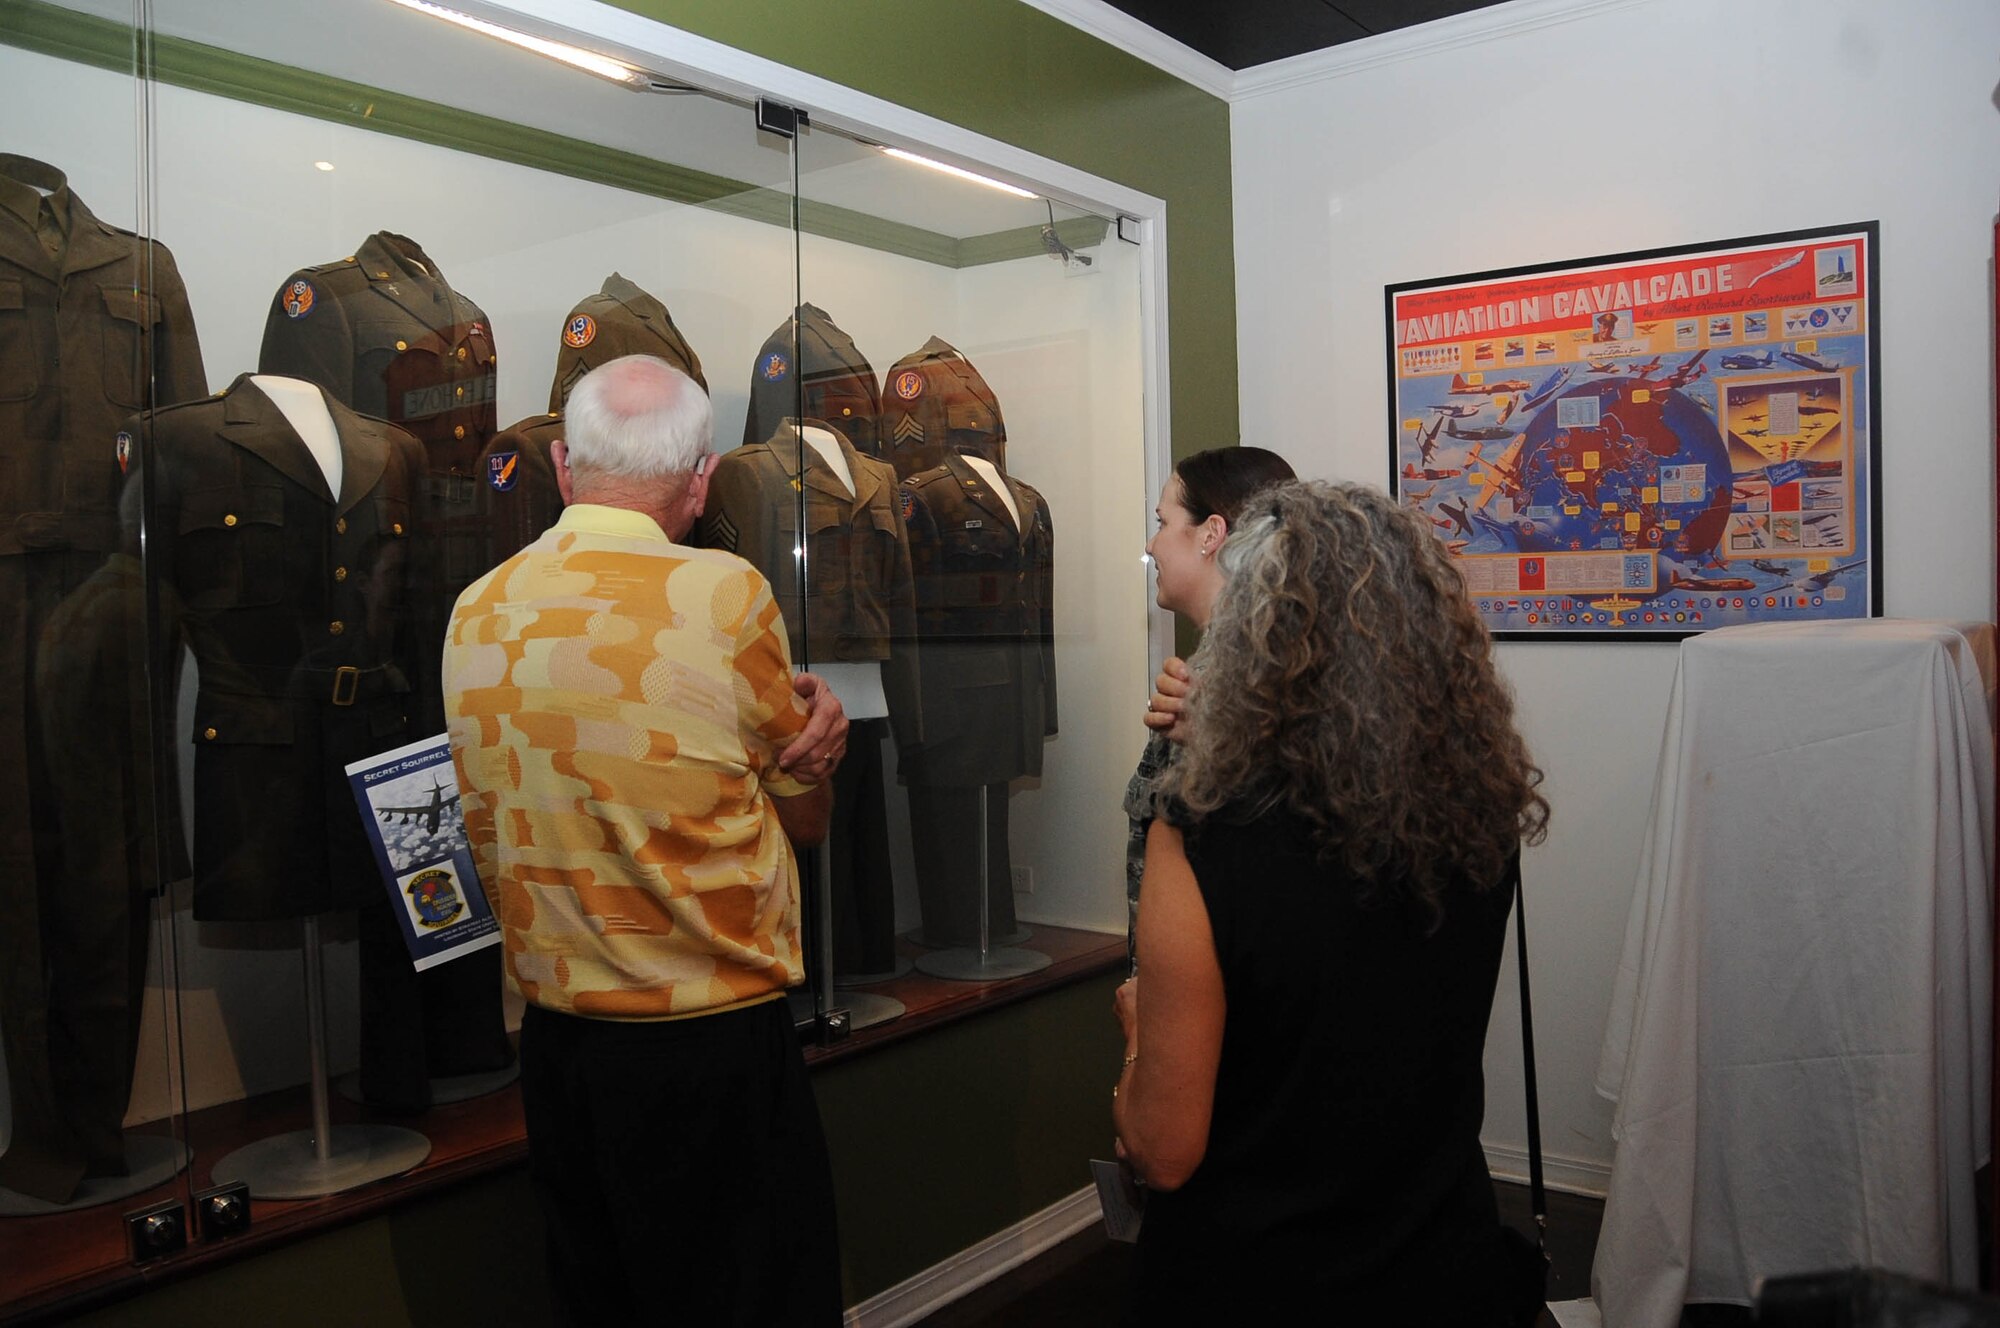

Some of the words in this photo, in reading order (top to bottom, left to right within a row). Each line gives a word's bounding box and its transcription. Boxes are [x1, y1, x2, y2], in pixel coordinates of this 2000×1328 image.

[1406, 296, 1541, 344] AVIATION
[1553, 263, 1733, 319] CAVALCADE
[572, 317, 585, 334] 13
[491, 456, 503, 470] 11
